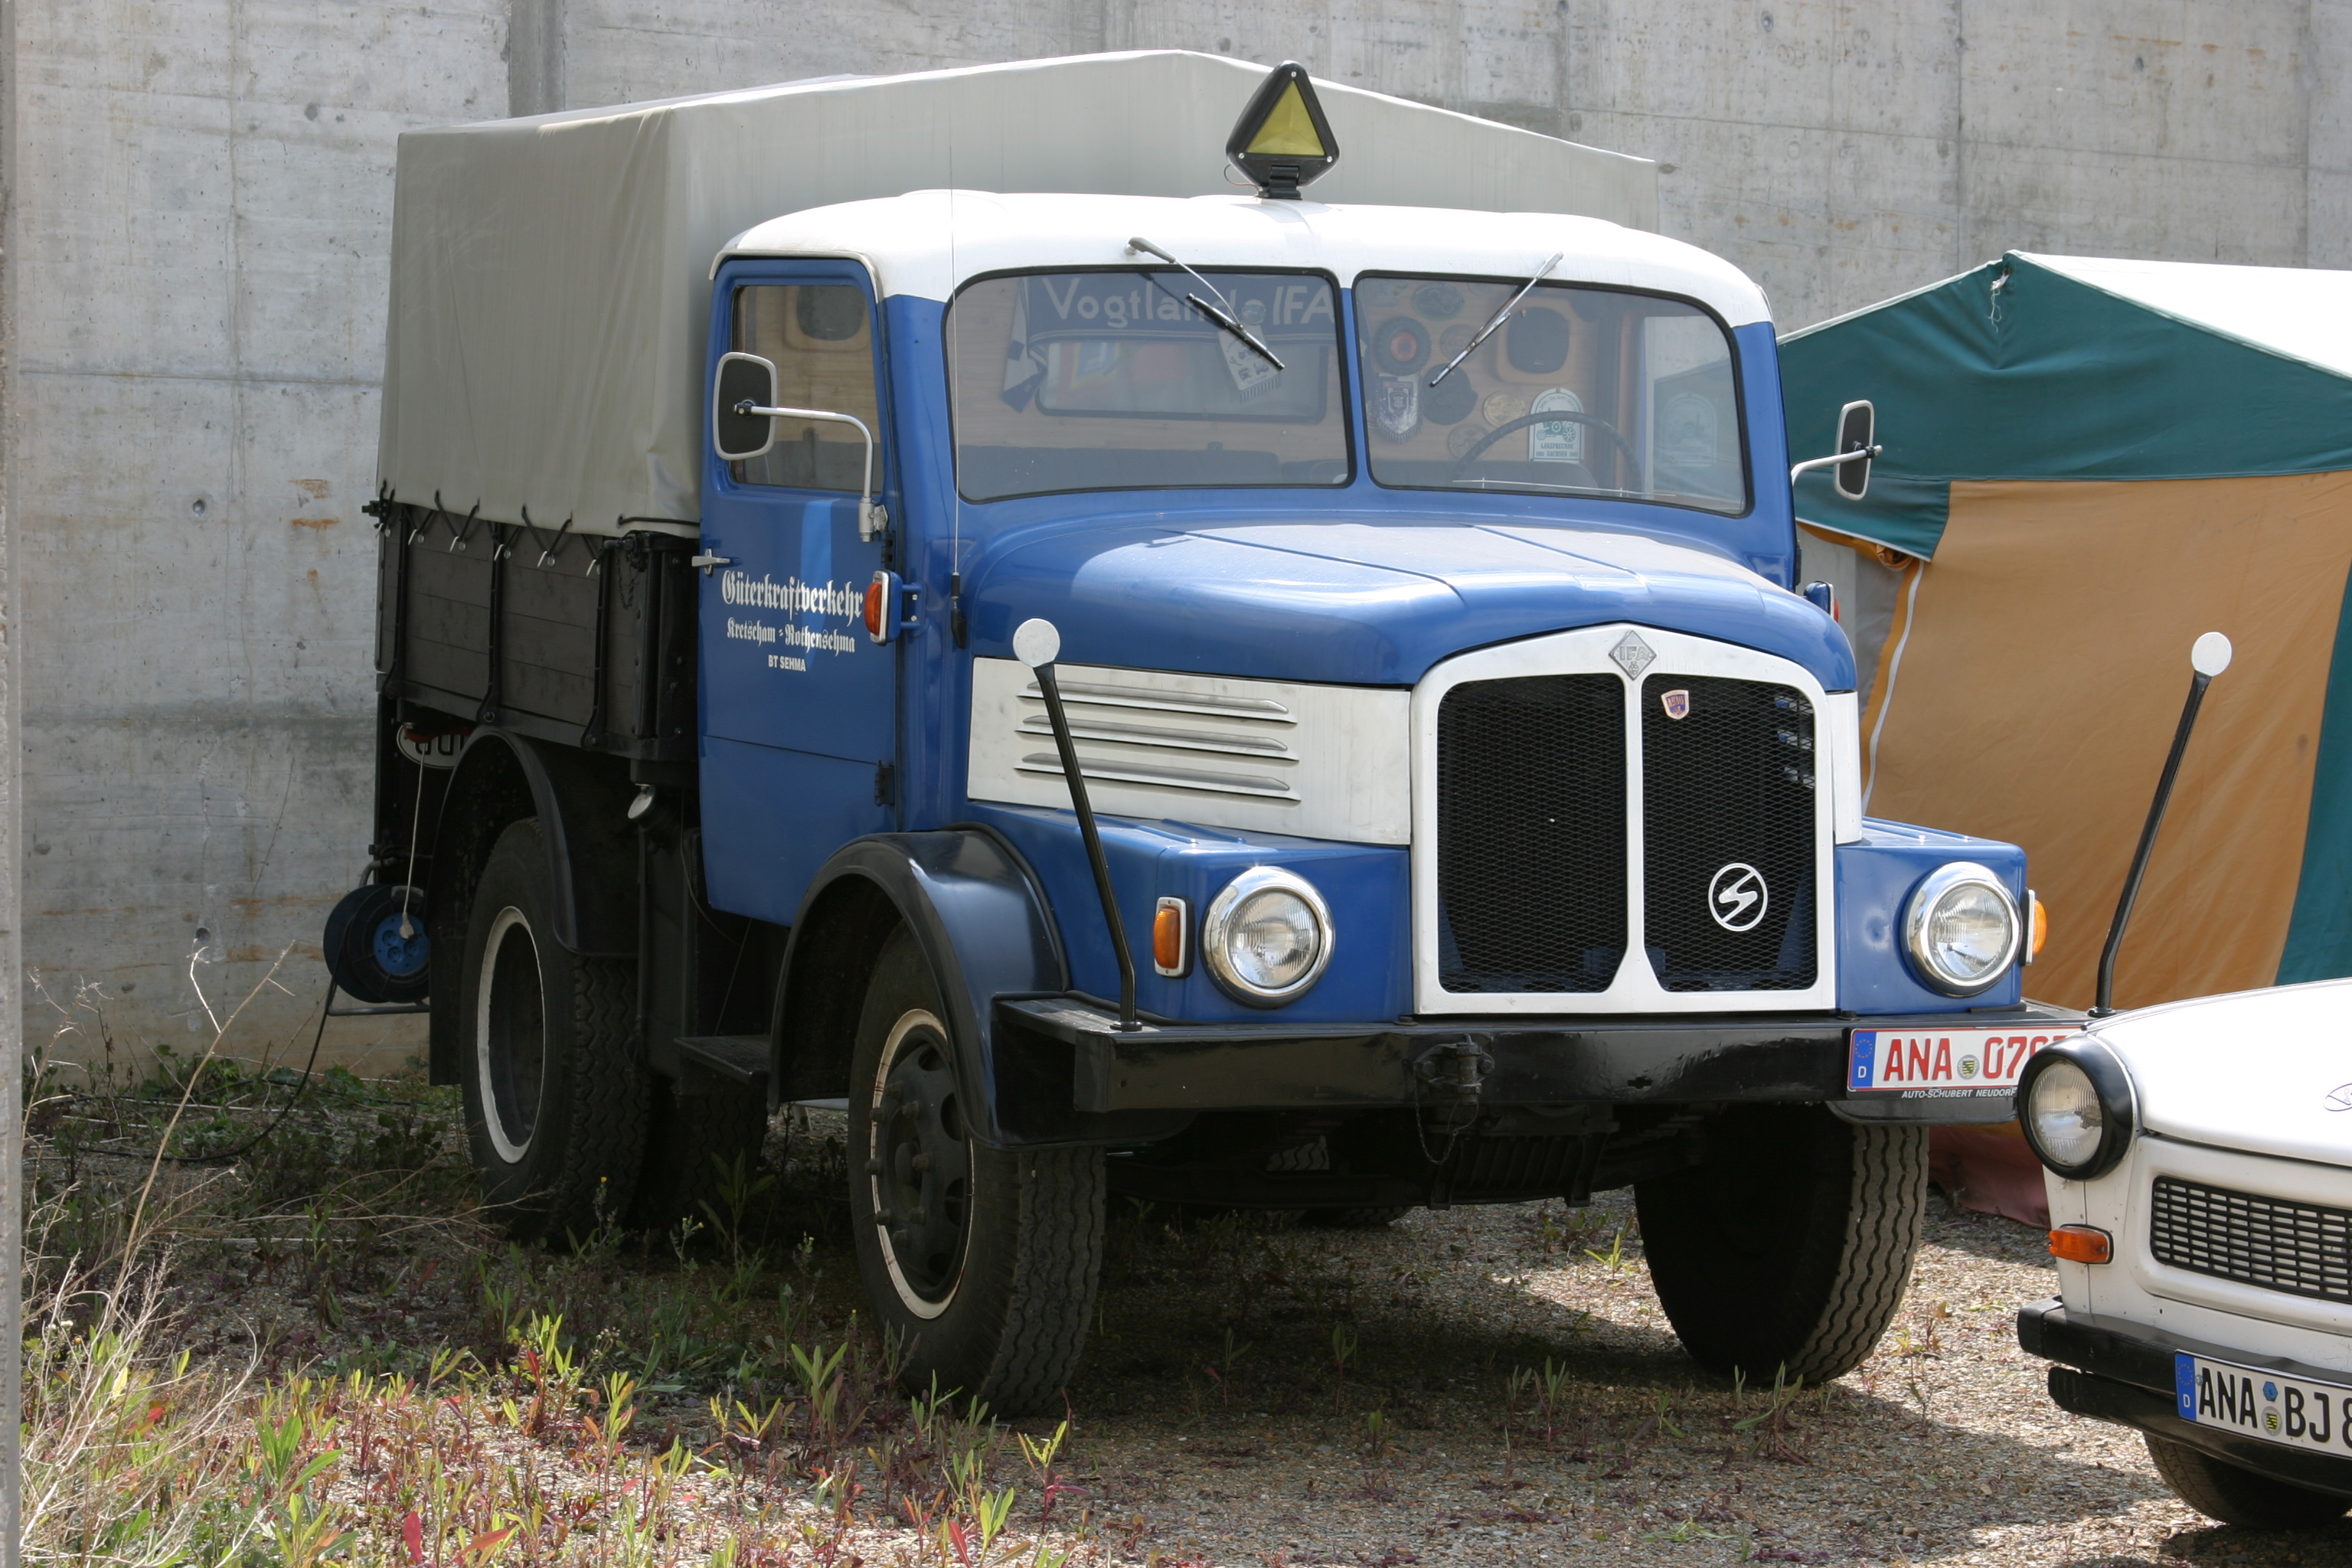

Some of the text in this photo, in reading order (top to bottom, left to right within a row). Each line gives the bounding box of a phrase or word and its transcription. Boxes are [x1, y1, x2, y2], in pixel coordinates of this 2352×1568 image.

[1272, 284, 1335, 325] IFA
[722, 570, 864, 627] Güterkraftverkehr
[768, 655, 806, 671] BT SEHMA
[1619, 645, 1649, 661] IFA
[1857, 1066, 1867, 1078] D
[1883, 1037, 1953, 1081] ANA
[1901, 1087, 2017, 1099] AUTO-SCHUBERT NEUDORF
[2183, 1393, 2190, 1408] D
[2199, 1367, 2258, 1429] ANA
[2284, 1386, 2331, 1443] BJ
